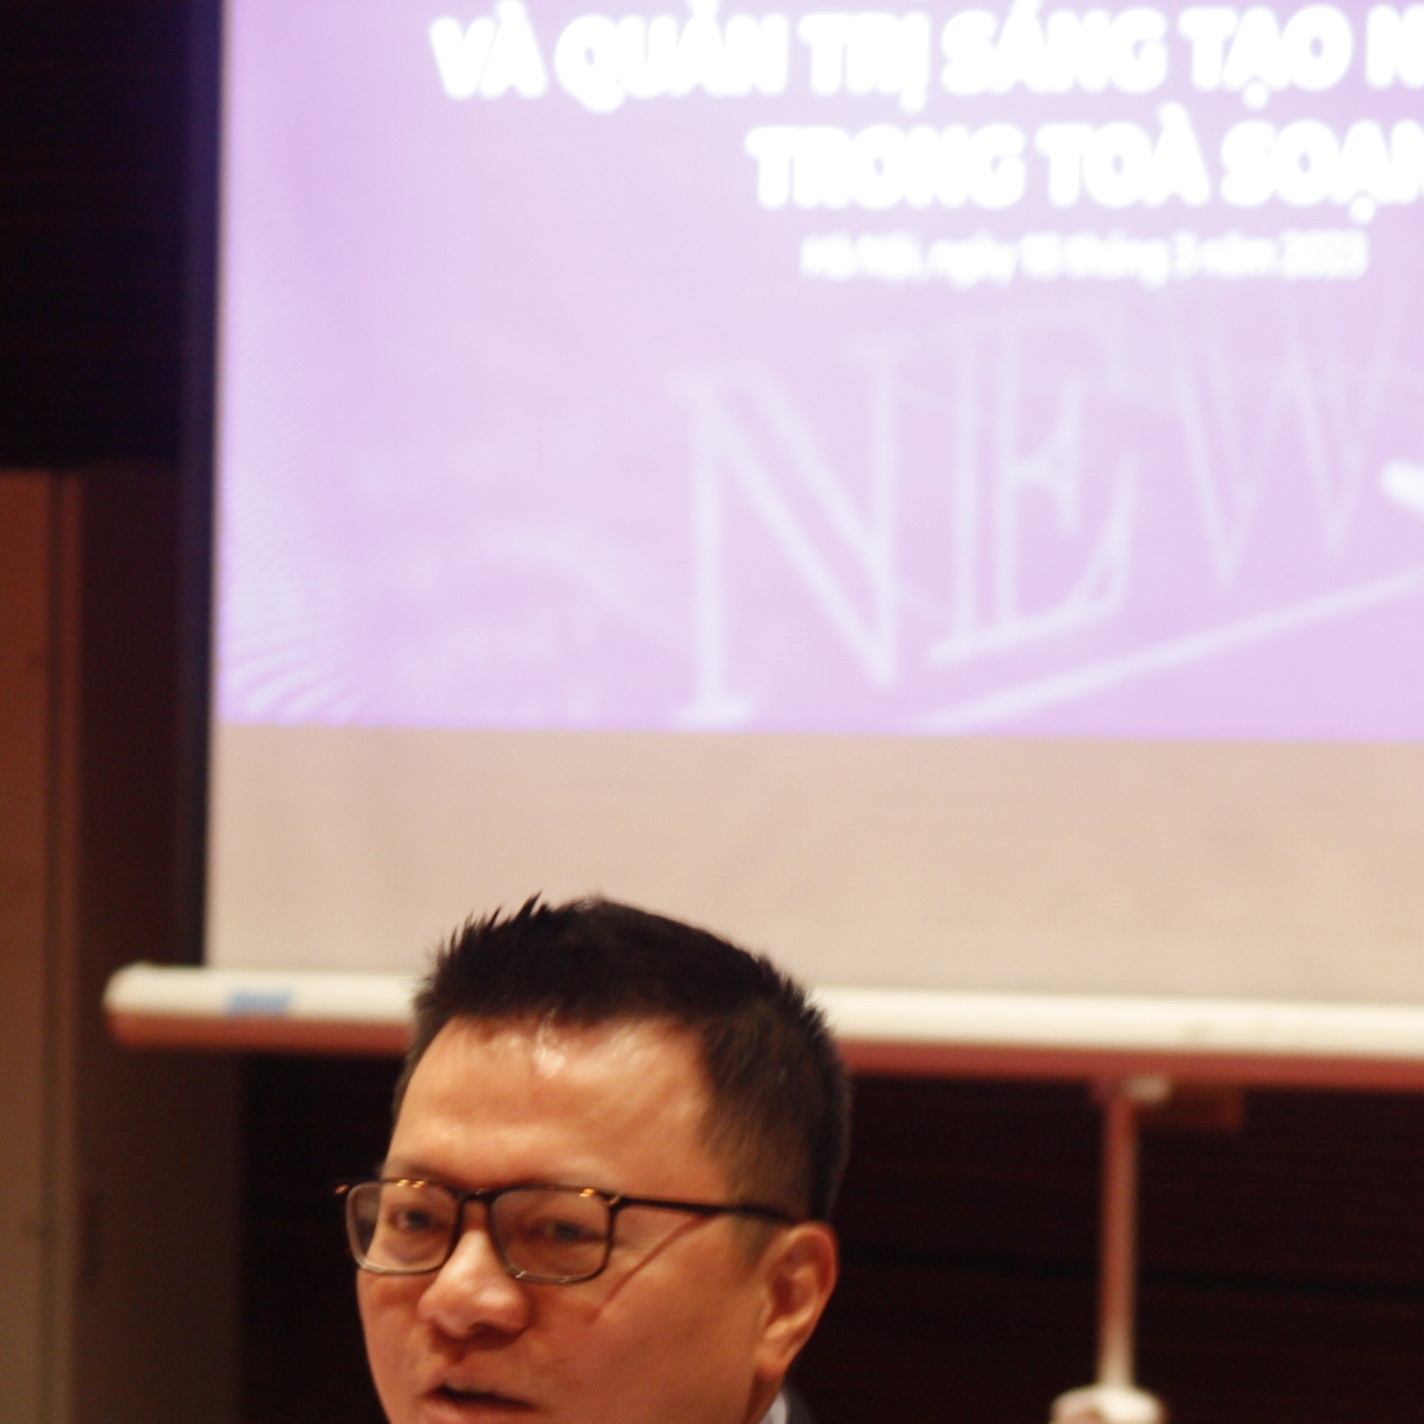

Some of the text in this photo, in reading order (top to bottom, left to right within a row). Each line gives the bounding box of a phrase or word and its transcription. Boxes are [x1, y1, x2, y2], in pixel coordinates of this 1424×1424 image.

[428, 0, 549, 98] VÀ
[554, 0, 790, 114] QUẢN
[796, 12, 931, 114] TRỊ
[939, 0, 1169, 94] SÁNG
[1177, 3, 1354, 111] TẠO
[743, 122, 1027, 209] TRONG
[1035, 100, 1212, 209] TOÀ
